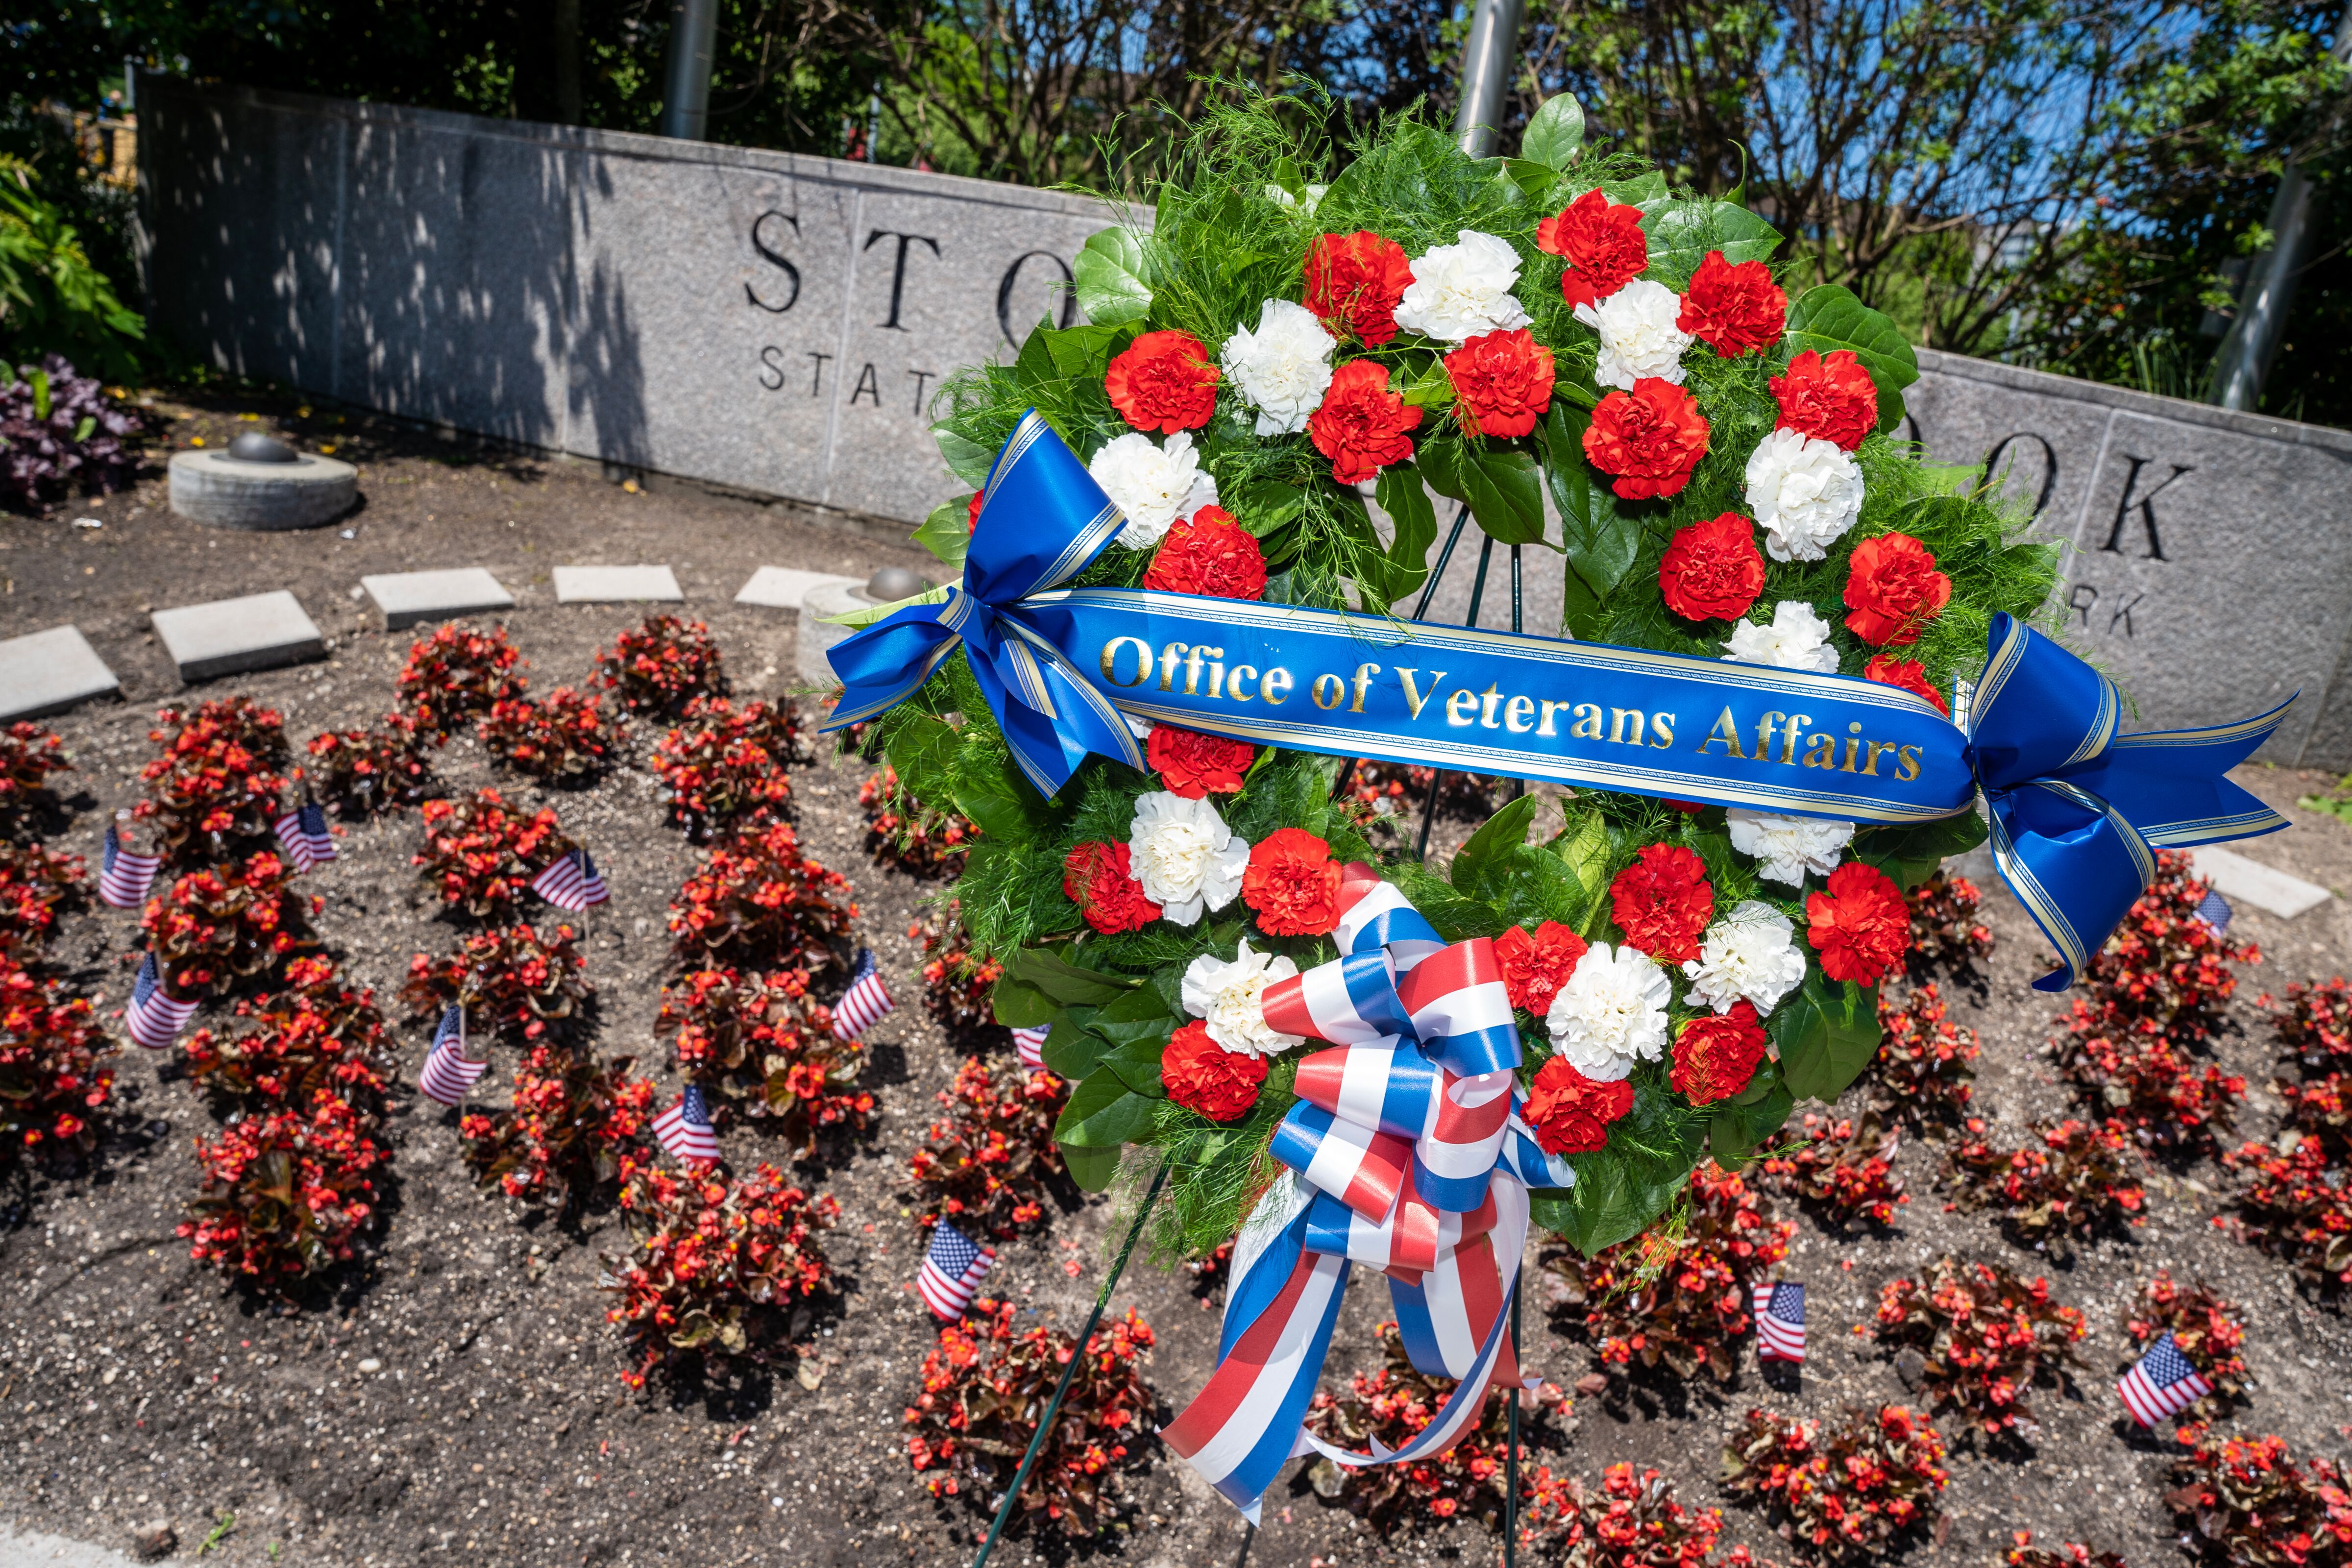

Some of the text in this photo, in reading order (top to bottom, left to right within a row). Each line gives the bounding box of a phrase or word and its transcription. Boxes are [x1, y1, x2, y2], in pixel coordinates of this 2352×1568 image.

[1099, 636, 1924, 782] Office of Veterans Affairs
